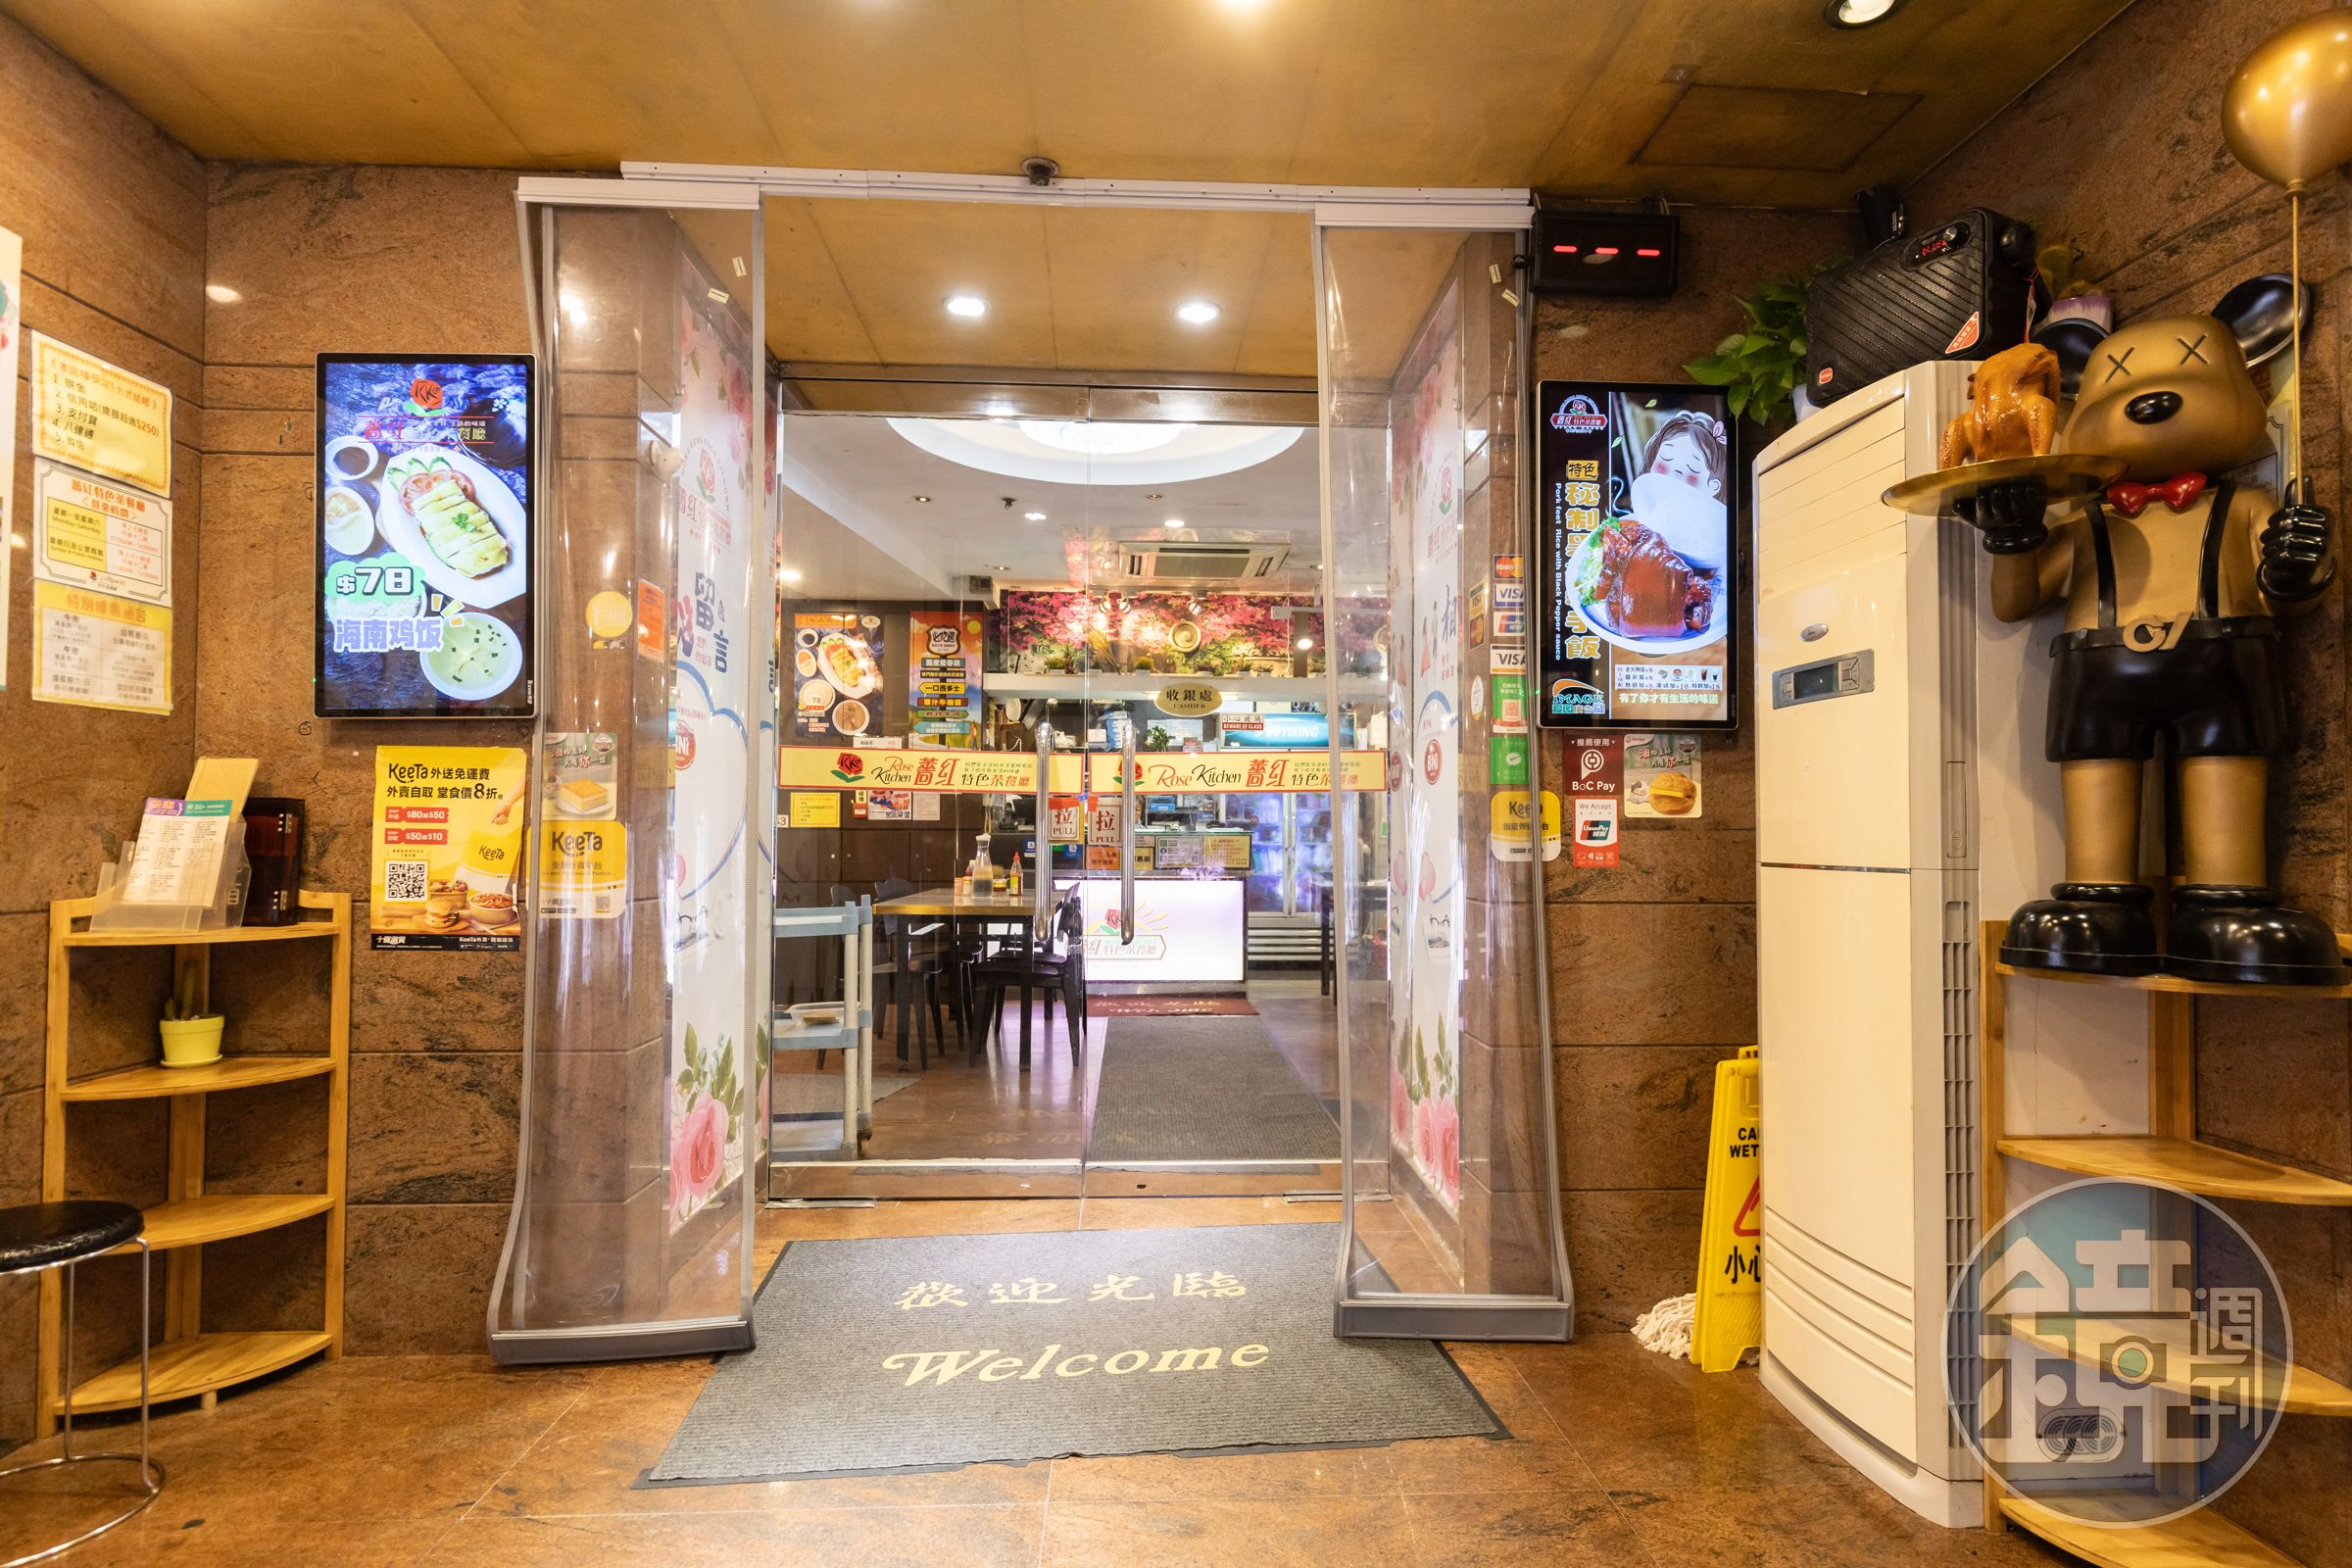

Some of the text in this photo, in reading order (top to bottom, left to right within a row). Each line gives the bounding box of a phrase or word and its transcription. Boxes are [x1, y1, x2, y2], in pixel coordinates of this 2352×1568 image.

[1569, 462, 1597, 478] 特色
[336, 566, 414, 595] $78
[335, 618, 443, 651] 海南鸡饭
[1166, 689, 1212, 702] 收銀處
[1619, 692, 1719, 704] 有了你才有生活的味道
[1577, 738, 1609, 747] 推薦使用
[885, 756, 913, 772] Rose
[389, 763, 490, 783] KeeTa 外送免運費
[871, 767, 911, 784] Kitchen
[962, 773, 1031, 787] 特色茶餐廳
[1149, 764, 1242, 788] Rose Kitchen
[387, 786, 433, 799] 外賣自取
[1572, 781, 1615, 793] BoC Pay
[1054, 808, 1073, 825] 拉
[1096, 810, 1115, 832] 拉
[1584, 824, 1609, 833] UnionPay
[479, 845, 505, 860] KeeTa
[551, 831, 603, 858] KeeTa
[1729, 1145, 1759, 1157] WET
[894, 1271, 1247, 1310] 歡迎光臨
[882, 1344, 1269, 1387] Welcome
